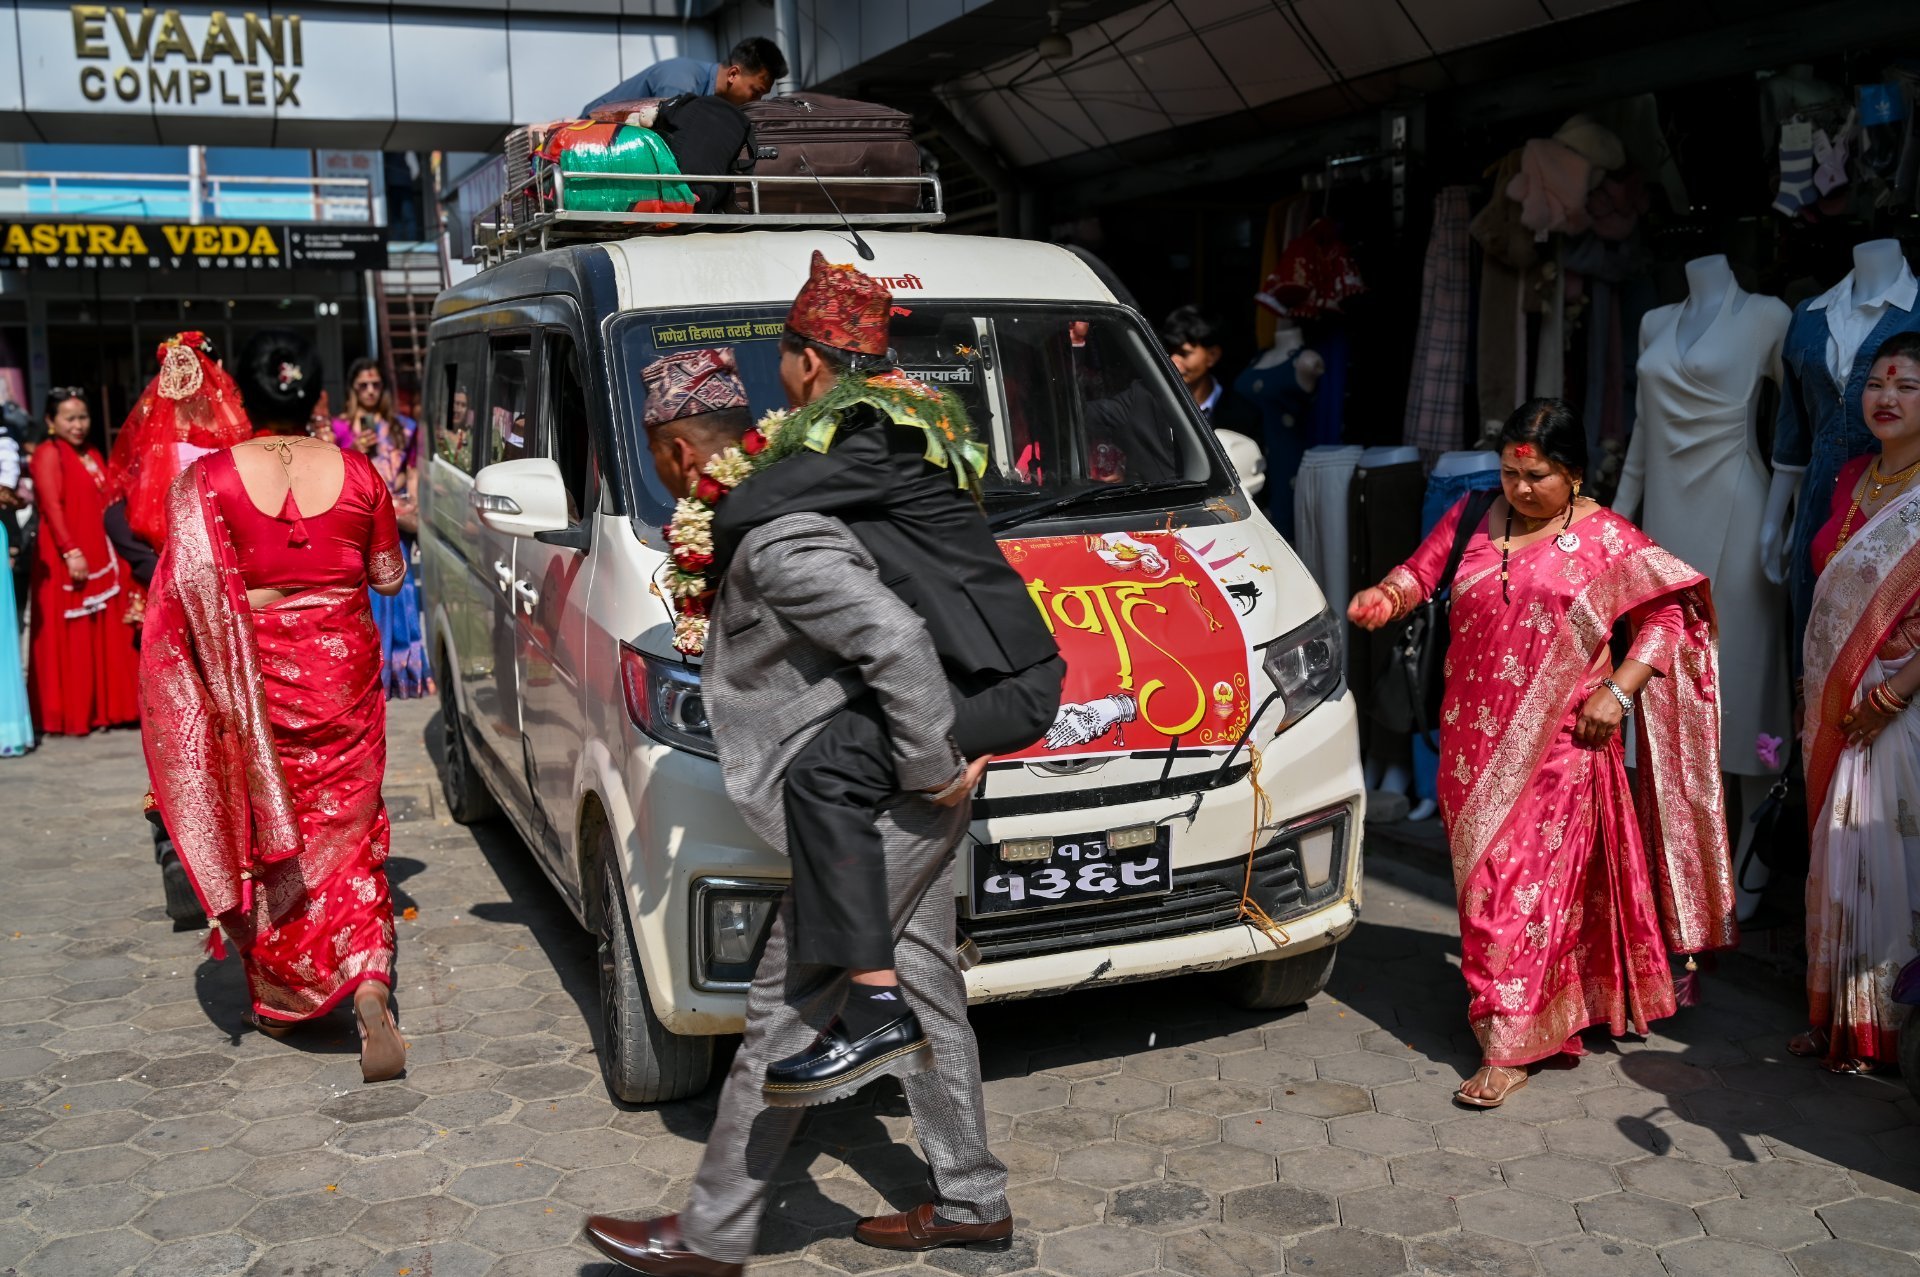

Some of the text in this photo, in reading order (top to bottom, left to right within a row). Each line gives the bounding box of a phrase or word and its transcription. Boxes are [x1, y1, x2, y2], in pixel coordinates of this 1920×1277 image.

[71, 4, 303, 66] EVAANI
[80, 66, 301, 107] COMPLEX
[0, 223, 279, 255] ASTRA VEDA
[46, 255, 132, 268] WOMEN
[198, 256, 280, 269] WOMEN
[868, 273, 923, 290] पानी
[657, 328, 688, 343] गणेश
[688, 325, 725, 340] हिमाल
[726, 322, 752, 337] तराई
[904, 367, 972, 381] सापानी
